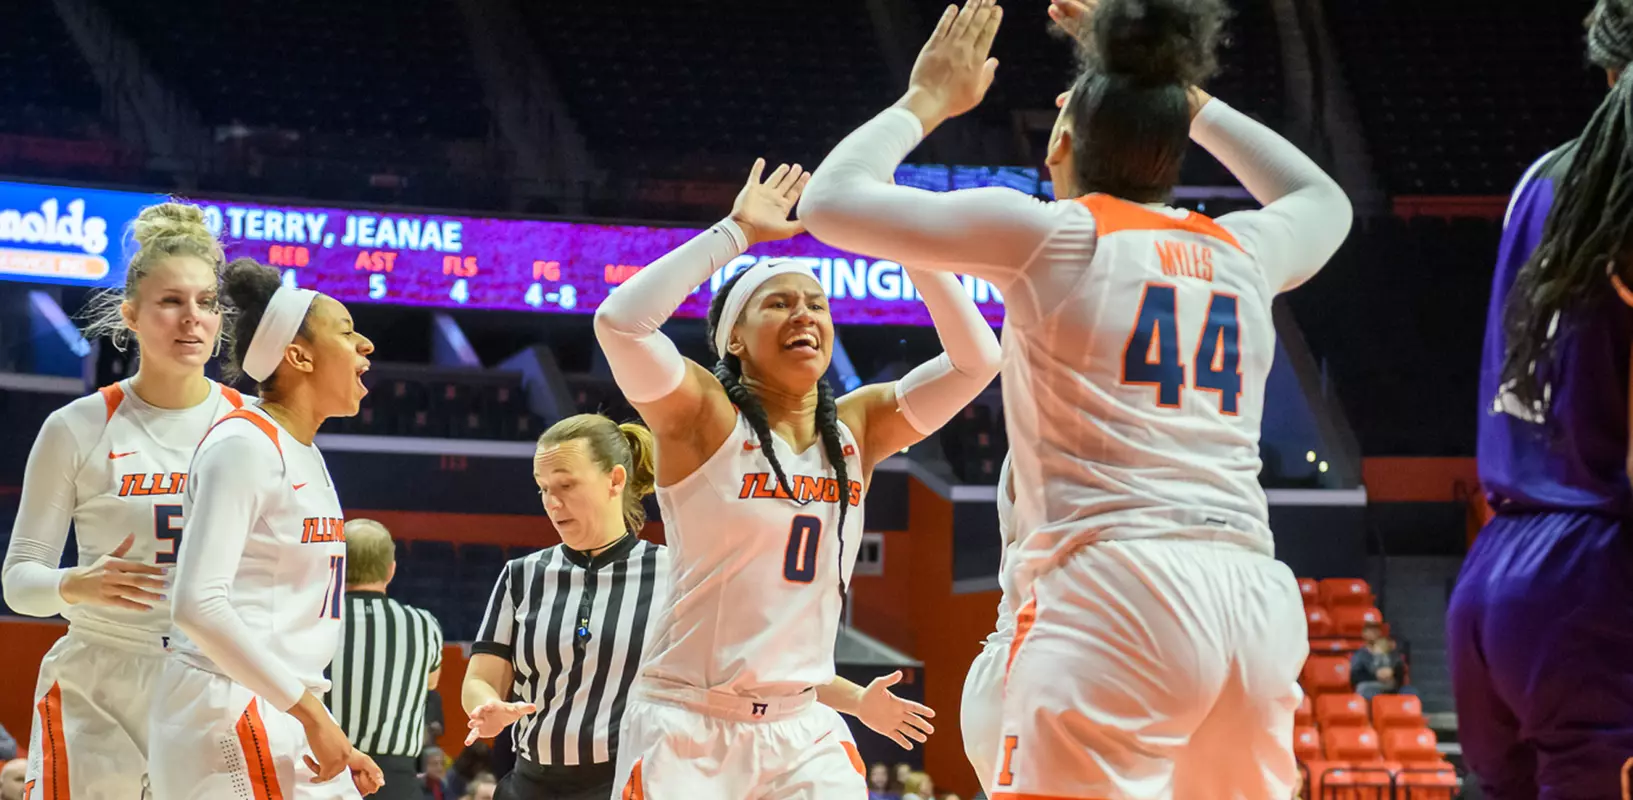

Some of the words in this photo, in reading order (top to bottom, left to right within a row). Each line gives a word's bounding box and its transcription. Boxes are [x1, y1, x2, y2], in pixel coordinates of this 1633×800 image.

[225, 207, 336, 249] TERRY,
[341, 216, 463, 251] JEANAE
[268, 245, 310, 268] REB
[354, 251, 398, 273] AST
[442, 255, 479, 277] FLS
[532, 260, 561, 282] FG
[1154, 239, 1214, 282] MYLES
[368, 273, 387, 300] 5
[449, 279, 469, 304] 4
[524, 282, 577, 309] 4-8
[1120, 281, 1243, 417] 44
[738, 472, 862, 507] ILLINOS
[152, 503, 184, 564] 5
[782, 513, 823, 584] 0
